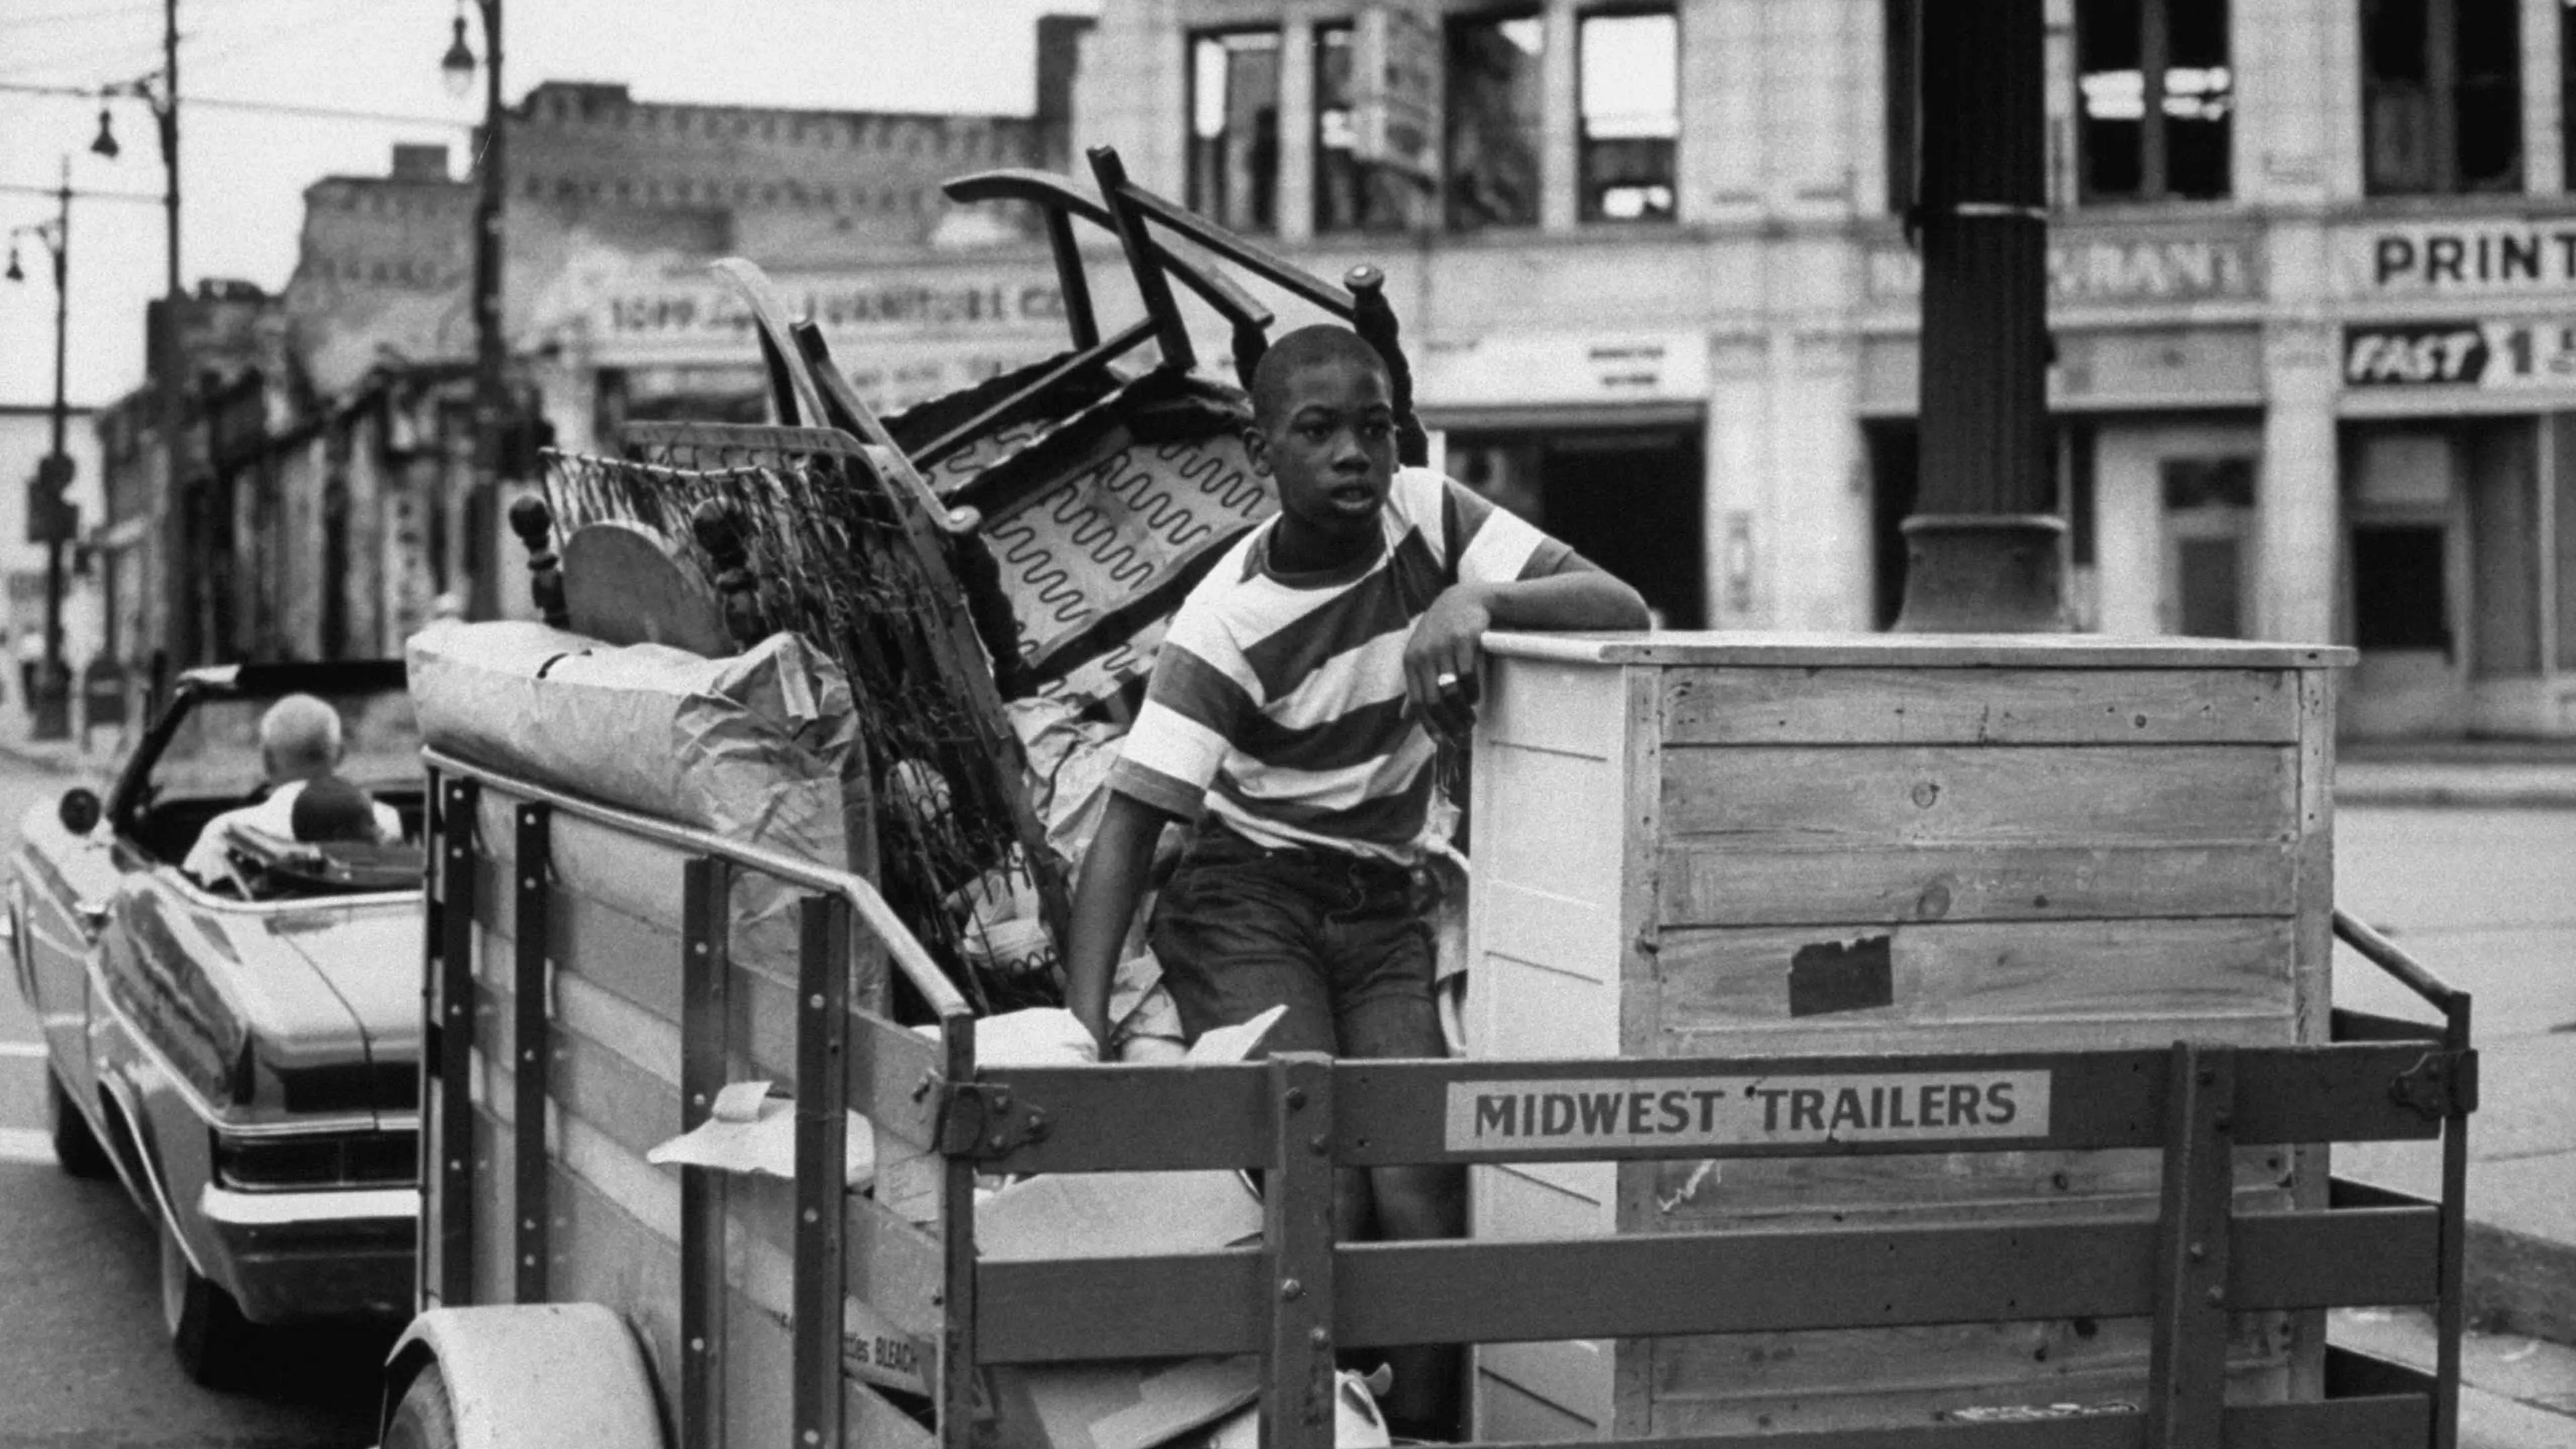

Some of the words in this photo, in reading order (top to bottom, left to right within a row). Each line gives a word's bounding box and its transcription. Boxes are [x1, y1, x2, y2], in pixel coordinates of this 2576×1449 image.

[2375, 232, 2576, 286] PRINT
[2349, 330, 2481, 381] FAST
[1475, 1089, 1725, 1136] MIDWEST
[1756, 1081, 2017, 1131] TRAILERS
[875, 1336, 918, 1375] BLEACH
